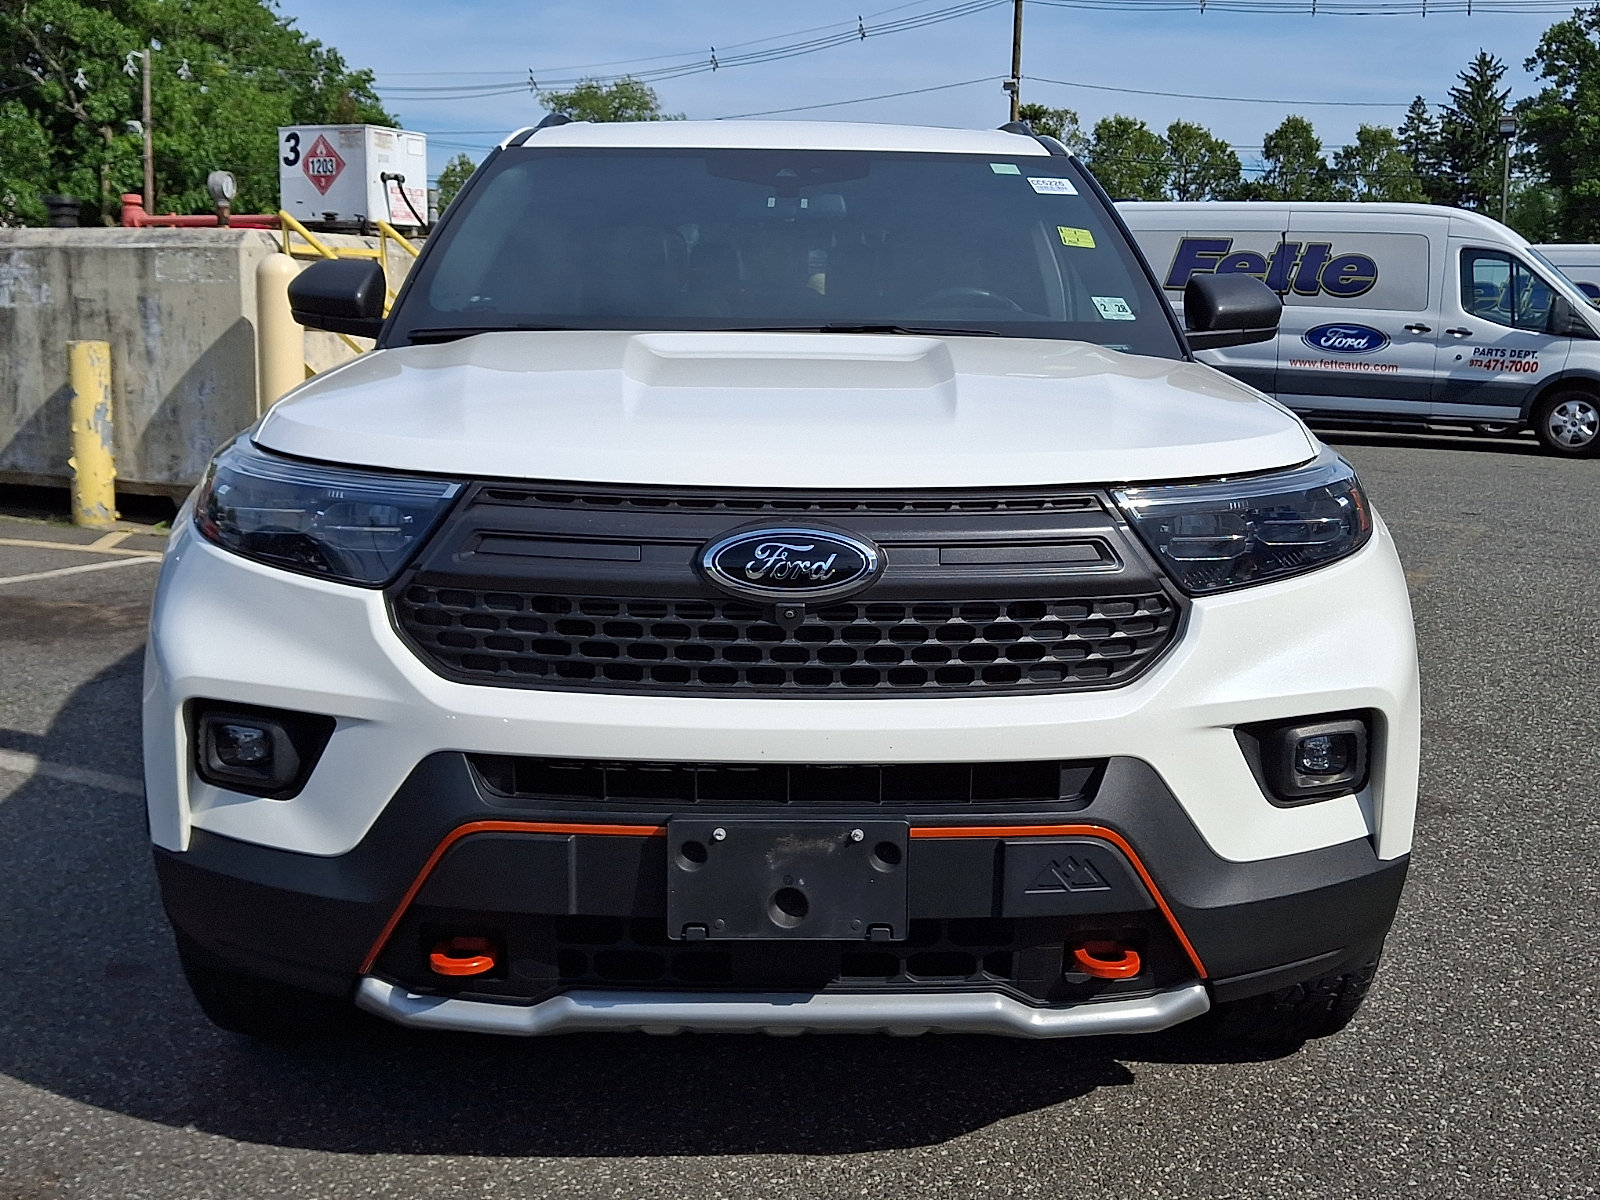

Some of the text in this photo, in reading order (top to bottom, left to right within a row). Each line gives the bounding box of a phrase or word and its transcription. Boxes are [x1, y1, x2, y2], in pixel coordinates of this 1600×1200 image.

[283, 132, 300, 167] 3
[310, 158, 334, 174] 1203
[1163, 236, 1379, 298] Fette
[1320, 328, 1368, 350] Ford
[1473, 347, 1539, 360] PARTS DEPT.
[1289, 358, 1399, 373] www.fetteauto.com
[1484, 359, 1540, 374] 471-7000
[745, 542, 838, 581] Ford
